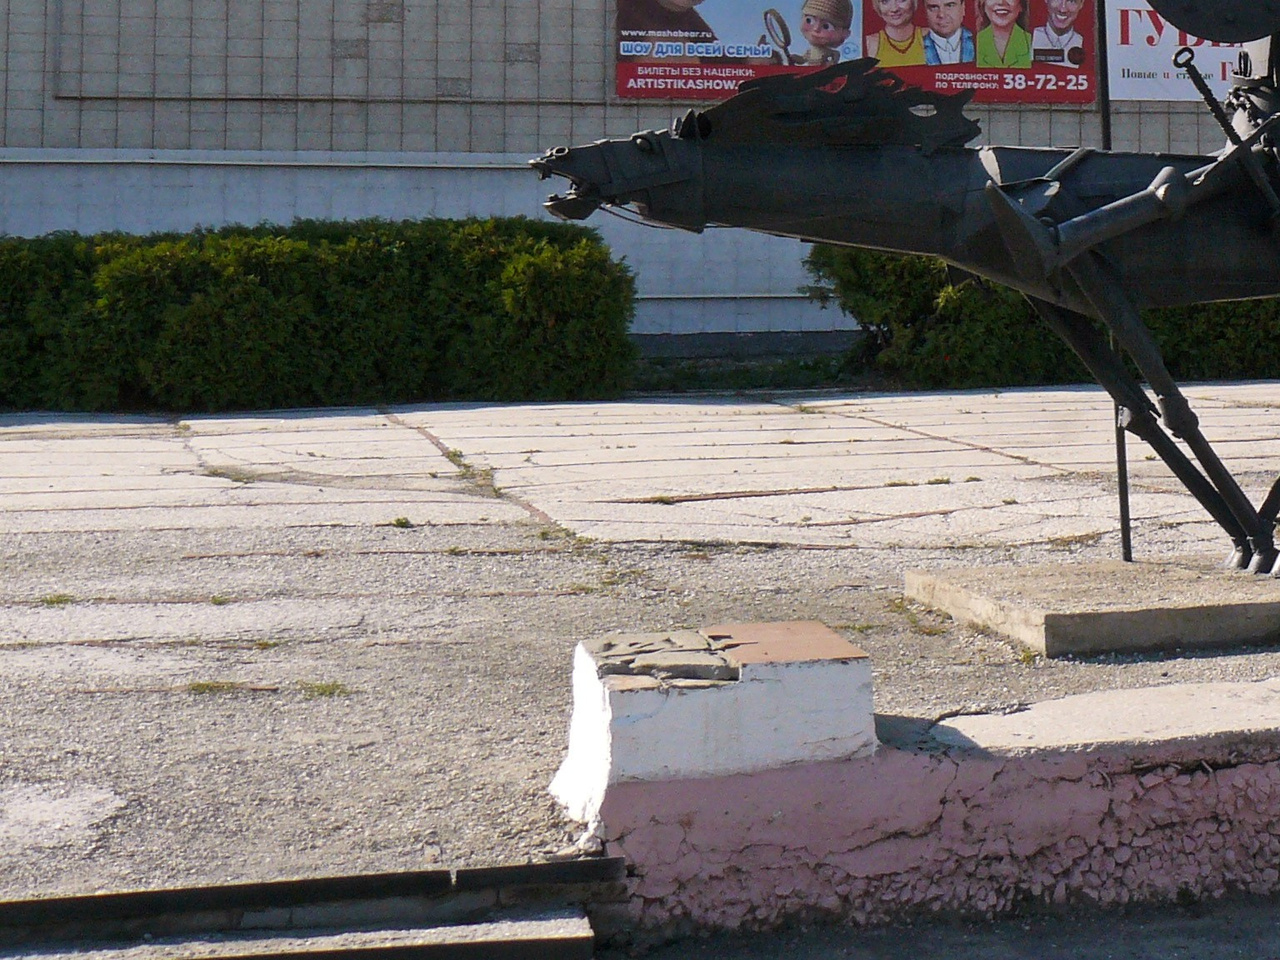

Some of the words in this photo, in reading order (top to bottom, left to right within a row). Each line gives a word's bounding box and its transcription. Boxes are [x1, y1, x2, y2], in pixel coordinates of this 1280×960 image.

[621, 30, 712, 38] www.mashabear.ru
[622, 42, 650, 55] ШОУ
[655, 43, 682, 56] ДЛЯ
[687, 43, 722, 56] ВСЕЙ
[724, 45, 771, 57] СЕМЬИ
[638, 66, 680, 75] БИЛЕТЫ
[682, 68, 701, 76] БЕЗ
[1163, 70, 1170, 79] и
[936, 73, 999, 81] ПОДРОБНОСТИ
[1003, 75, 1088, 90] 38-72-25
